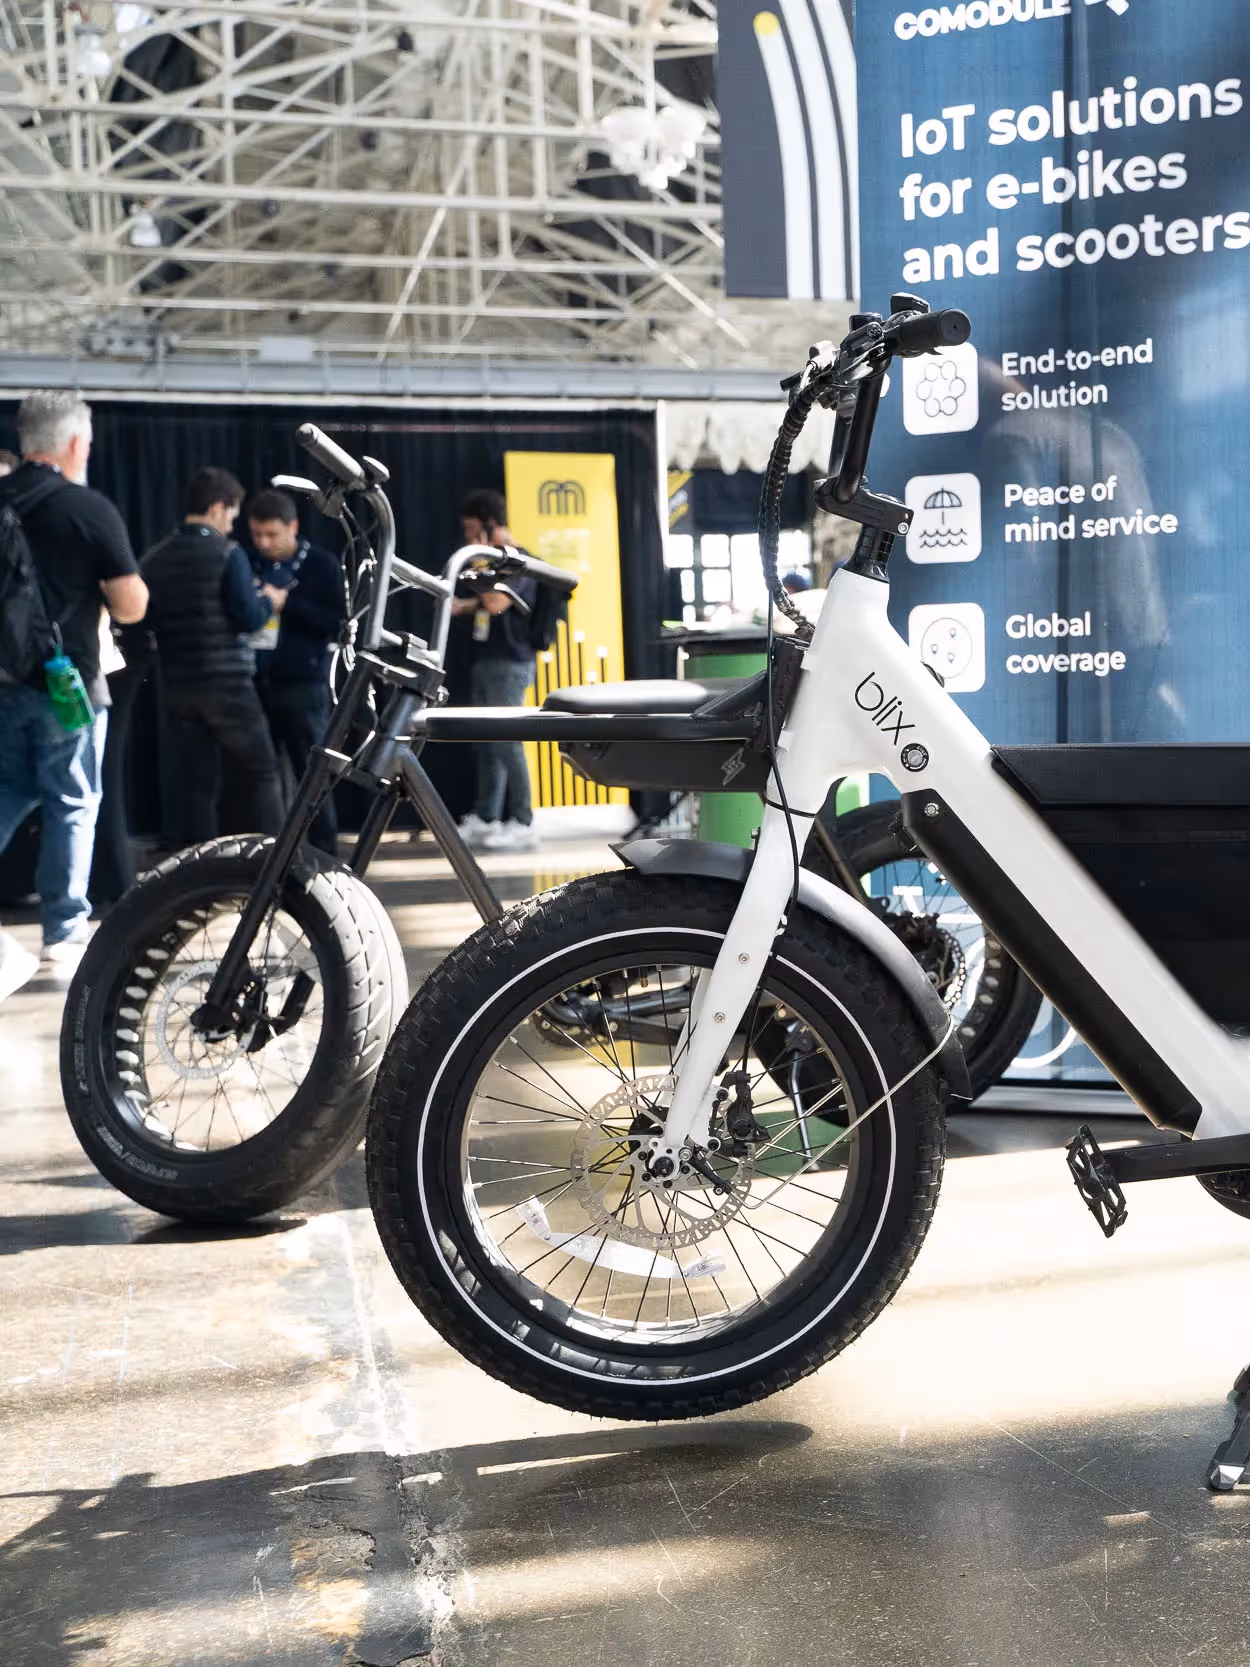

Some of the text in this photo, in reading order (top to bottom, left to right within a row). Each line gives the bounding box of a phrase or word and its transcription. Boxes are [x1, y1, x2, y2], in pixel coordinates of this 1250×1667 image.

[894, 0, 1071, 40] COMODULE
[901, 76, 1243, 158] IoT solutions
[899, 149, 1187, 221] for e-bikes
[902, 227, 1000, 284] and
[1001, 337, 1154, 378] End-to-end
[1001, 380, 1108, 411] solution
[1004, 474, 1119, 508] Peace of
[1004, 508, 1178, 543] mind service
[1005, 611, 1091, 639] Global
[1005, 651, 1127, 677] coverage
[854, 671, 916, 746] blix
